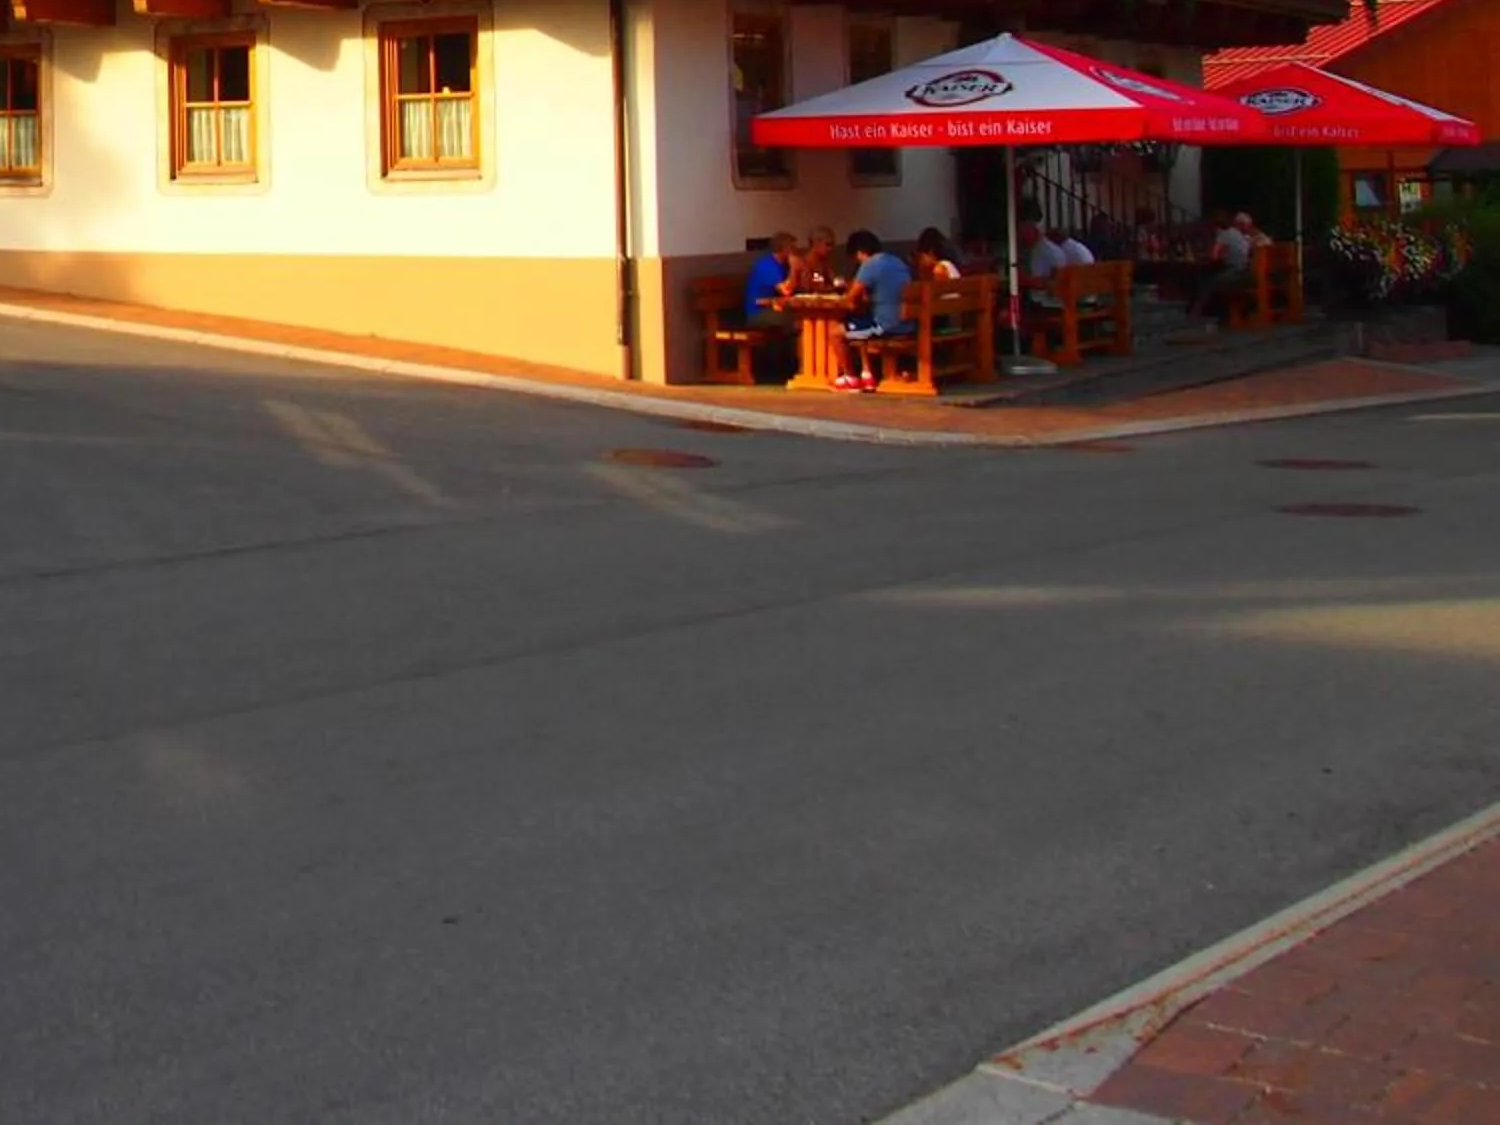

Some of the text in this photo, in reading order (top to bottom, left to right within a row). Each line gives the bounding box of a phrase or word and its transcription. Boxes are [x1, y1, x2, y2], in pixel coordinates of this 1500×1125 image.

[829, 123, 860, 140] Hast
[865, 124, 886, 139] ein
[890, 123, 933, 138] Kaiser
[947, 120, 975, 136] bist
[979, 120, 1001, 135] ein
[1006, 119, 1052, 135] Kaiser
